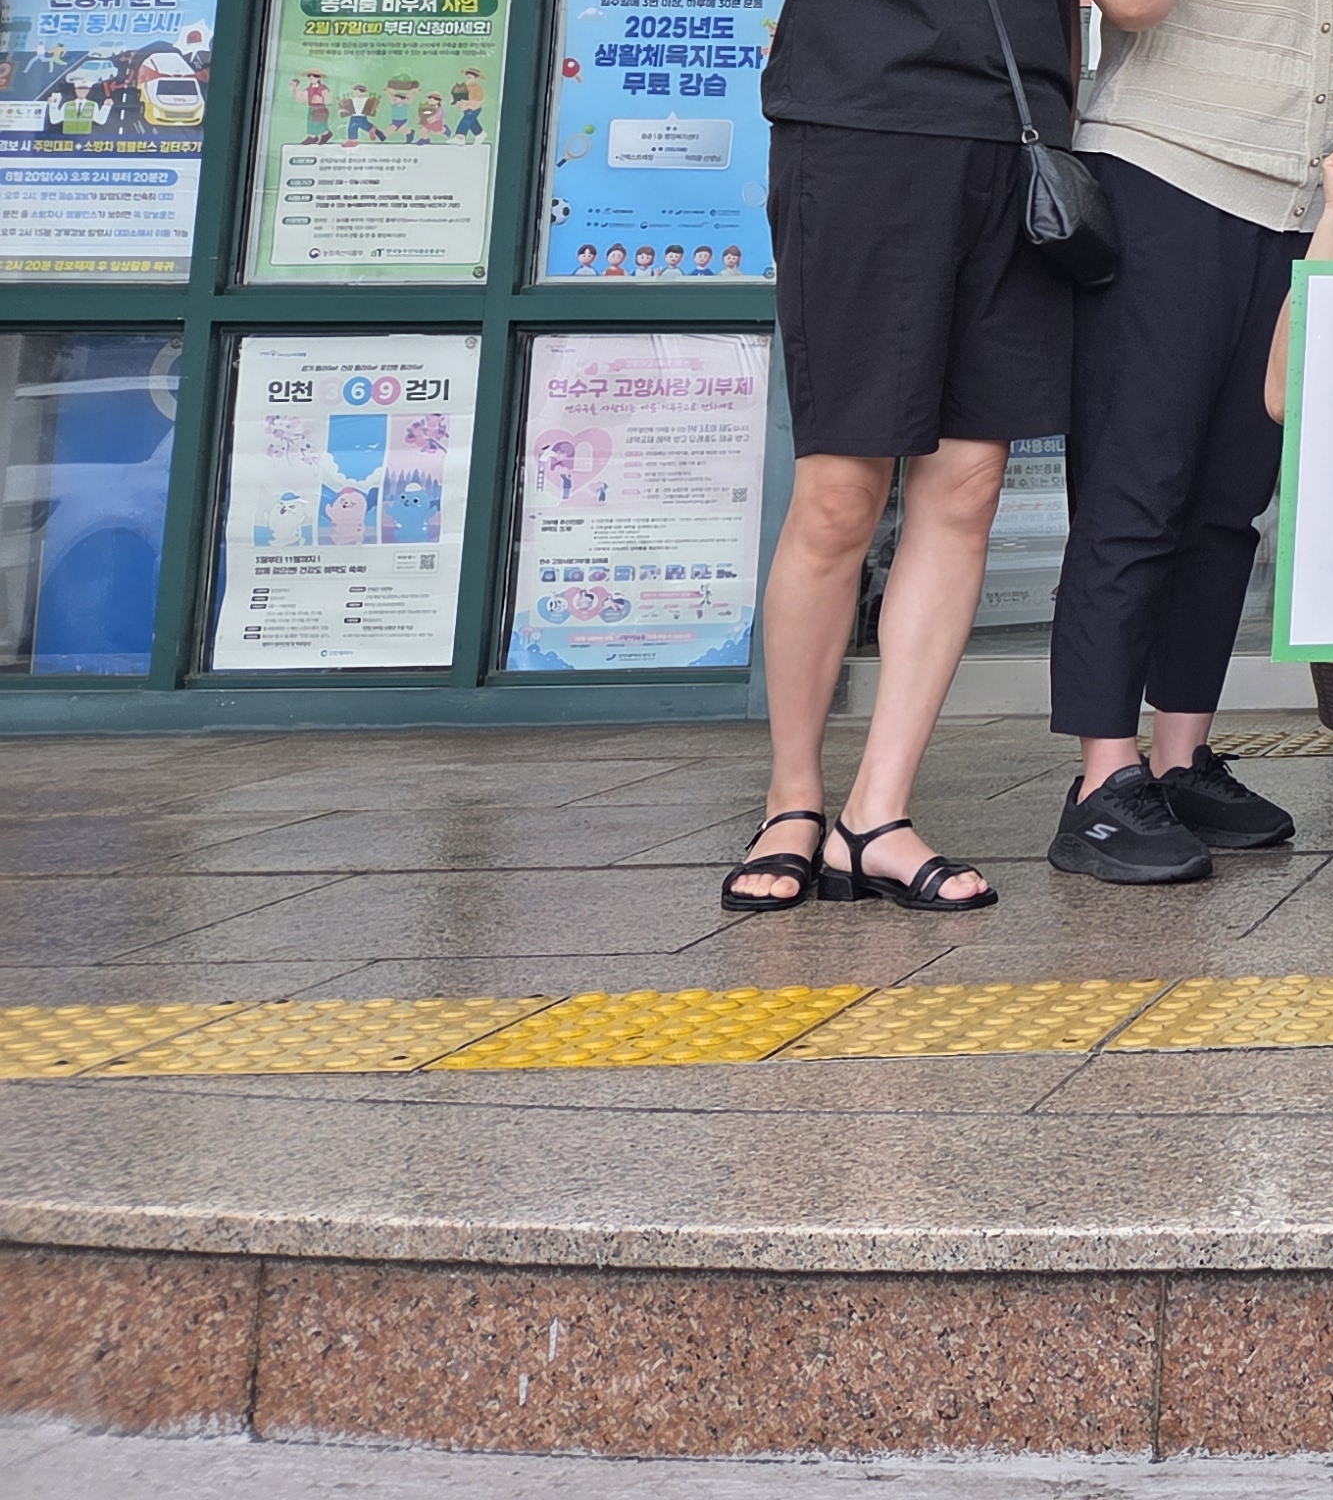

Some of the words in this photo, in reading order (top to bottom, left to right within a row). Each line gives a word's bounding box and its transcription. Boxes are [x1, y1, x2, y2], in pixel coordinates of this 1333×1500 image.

[719, 0, 741, 8] 30분
[743, 0, 763, 8] 운동
[39, 13, 79, 34] 전국
[87, 13, 126, 33] 동시
[133, 13, 180, 33] 실시!
[306, 21, 329, 34] 2월
[384, 21, 413, 35] 부터
[417, 21, 490, 35] 신청하세요!
[625, 16, 734, 39] 2025년도
[595, 43, 763, 69] 생활체육지도자
[623, 72, 670, 95] 무료
[680, 73, 727, 97] 강습
[21, 141, 31, 151] 시
[34, 141, 73, 151] 주민대피
[83, 141, 114, 152] 소방차
[117, 141, 157, 152] 앰뷸런스
[160, 141, 201, 153] 길터주기
[5, 172, 23, 181] 8월
[25, 172, 68, 182] 20일(수)
[71, 172, 90, 182] 오후
[93, 172, 109, 182] 2시
[112, 172, 131, 182] 부터
[133, 172, 168, 183] 20분간
[19, 229, 32, 237] 2시
[6, 261, 23, 271] 2시
[268, 380, 313, 402] 인천
[406, 379, 450, 401] 걷기
[548, 378, 608, 398] 연수구
[613, 377, 691, 397] 고향사랑
[694, 376, 753, 396] 기부제
[1019, 478, 1028, 488] 수
[1030, 478, 1049, 488] 있는
